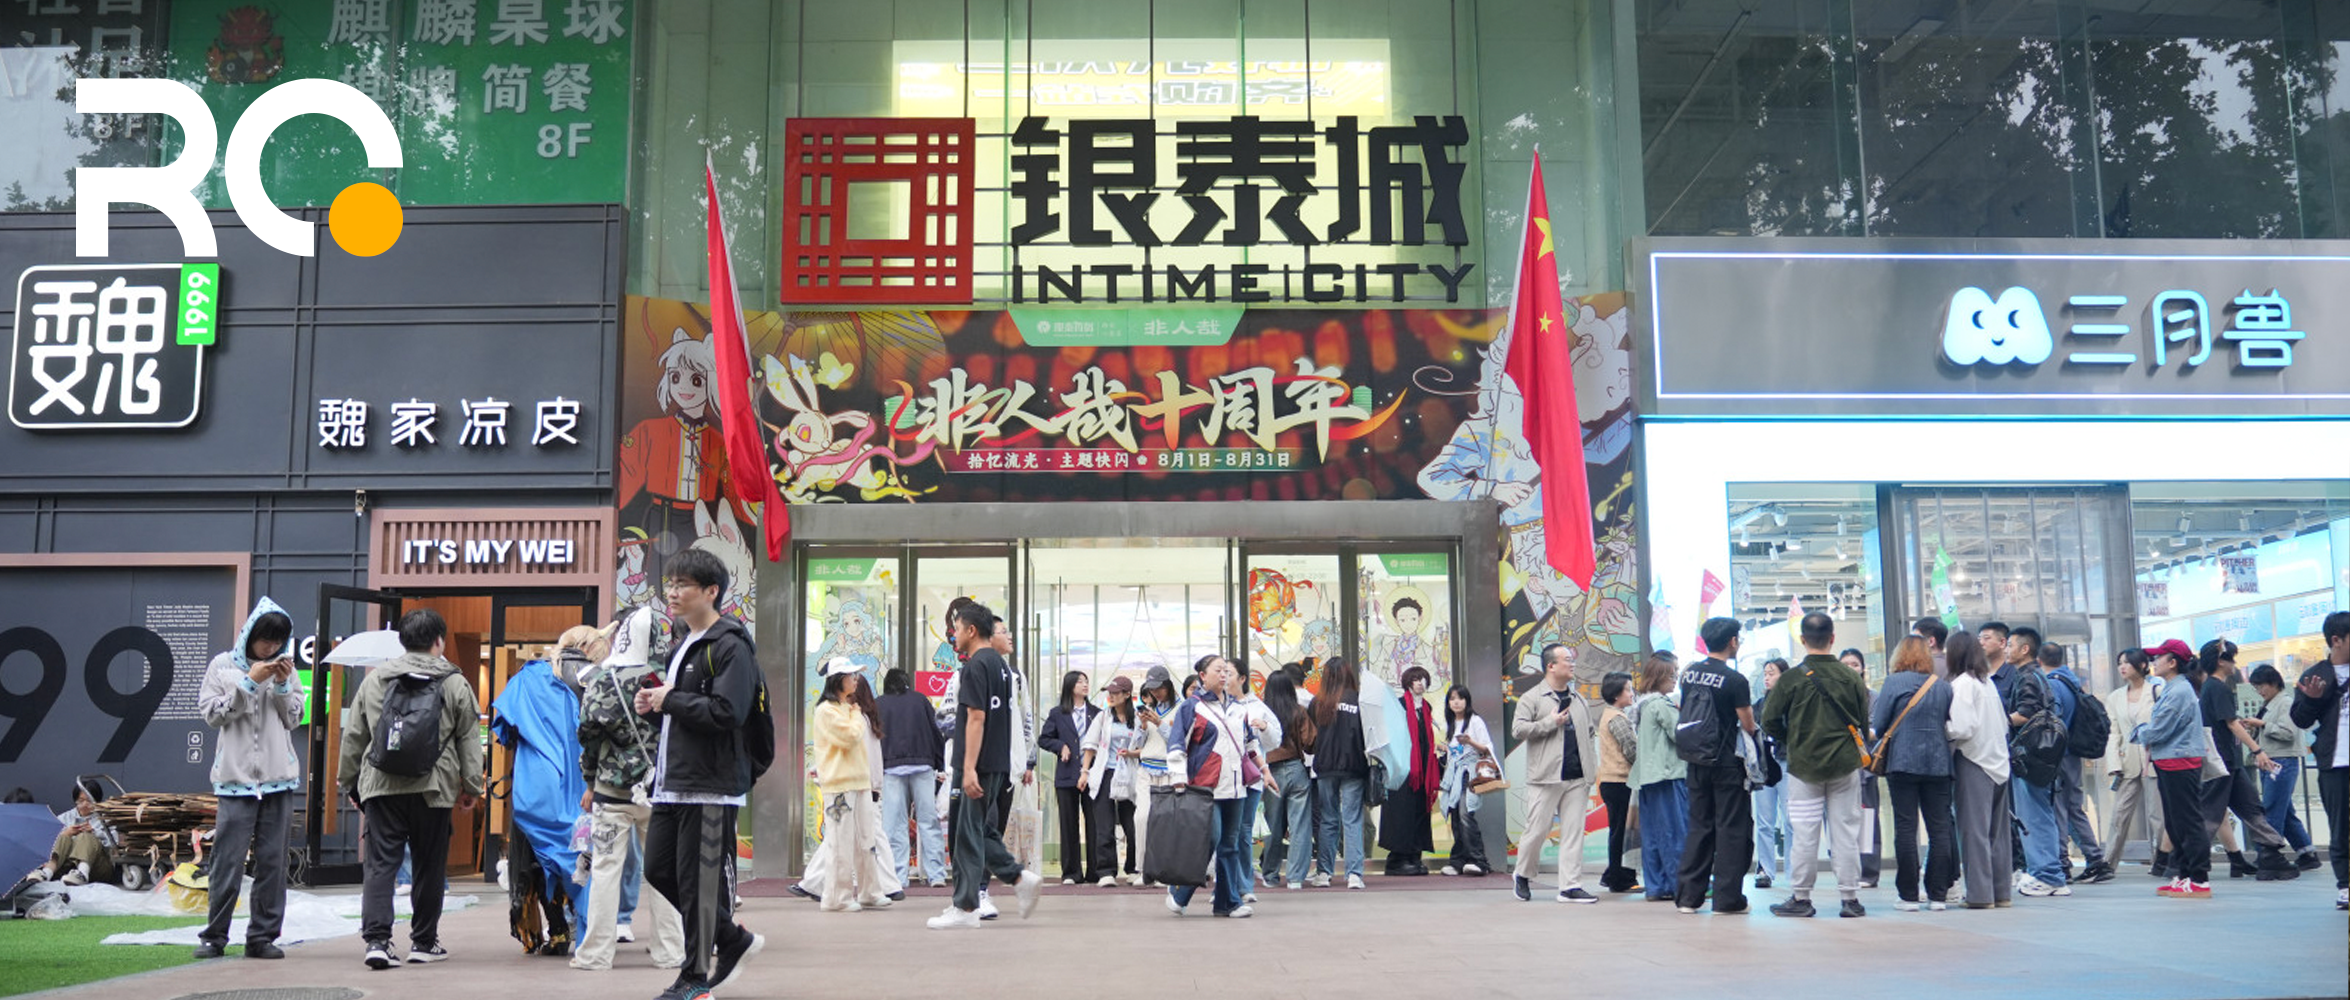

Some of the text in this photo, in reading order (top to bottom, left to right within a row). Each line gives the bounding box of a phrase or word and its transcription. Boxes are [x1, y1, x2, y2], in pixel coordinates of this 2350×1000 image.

[537, 123, 593, 159] 8F
[1011, 115, 1468, 247] 银泰城
[183, 272, 211, 338] 1999
[1144, 319, 1222, 337] 非人哉
[2069, 288, 2306, 368] 三月兽
[29, 276, 168, 416] 魏
[318, 397, 583, 447] 魏家凉皮
[912, 358, 1372, 465] 非人哉十周年
[403, 539, 574, 564] IT'S MY WEI
[1681, 669, 1726, 689] POLIZEI
